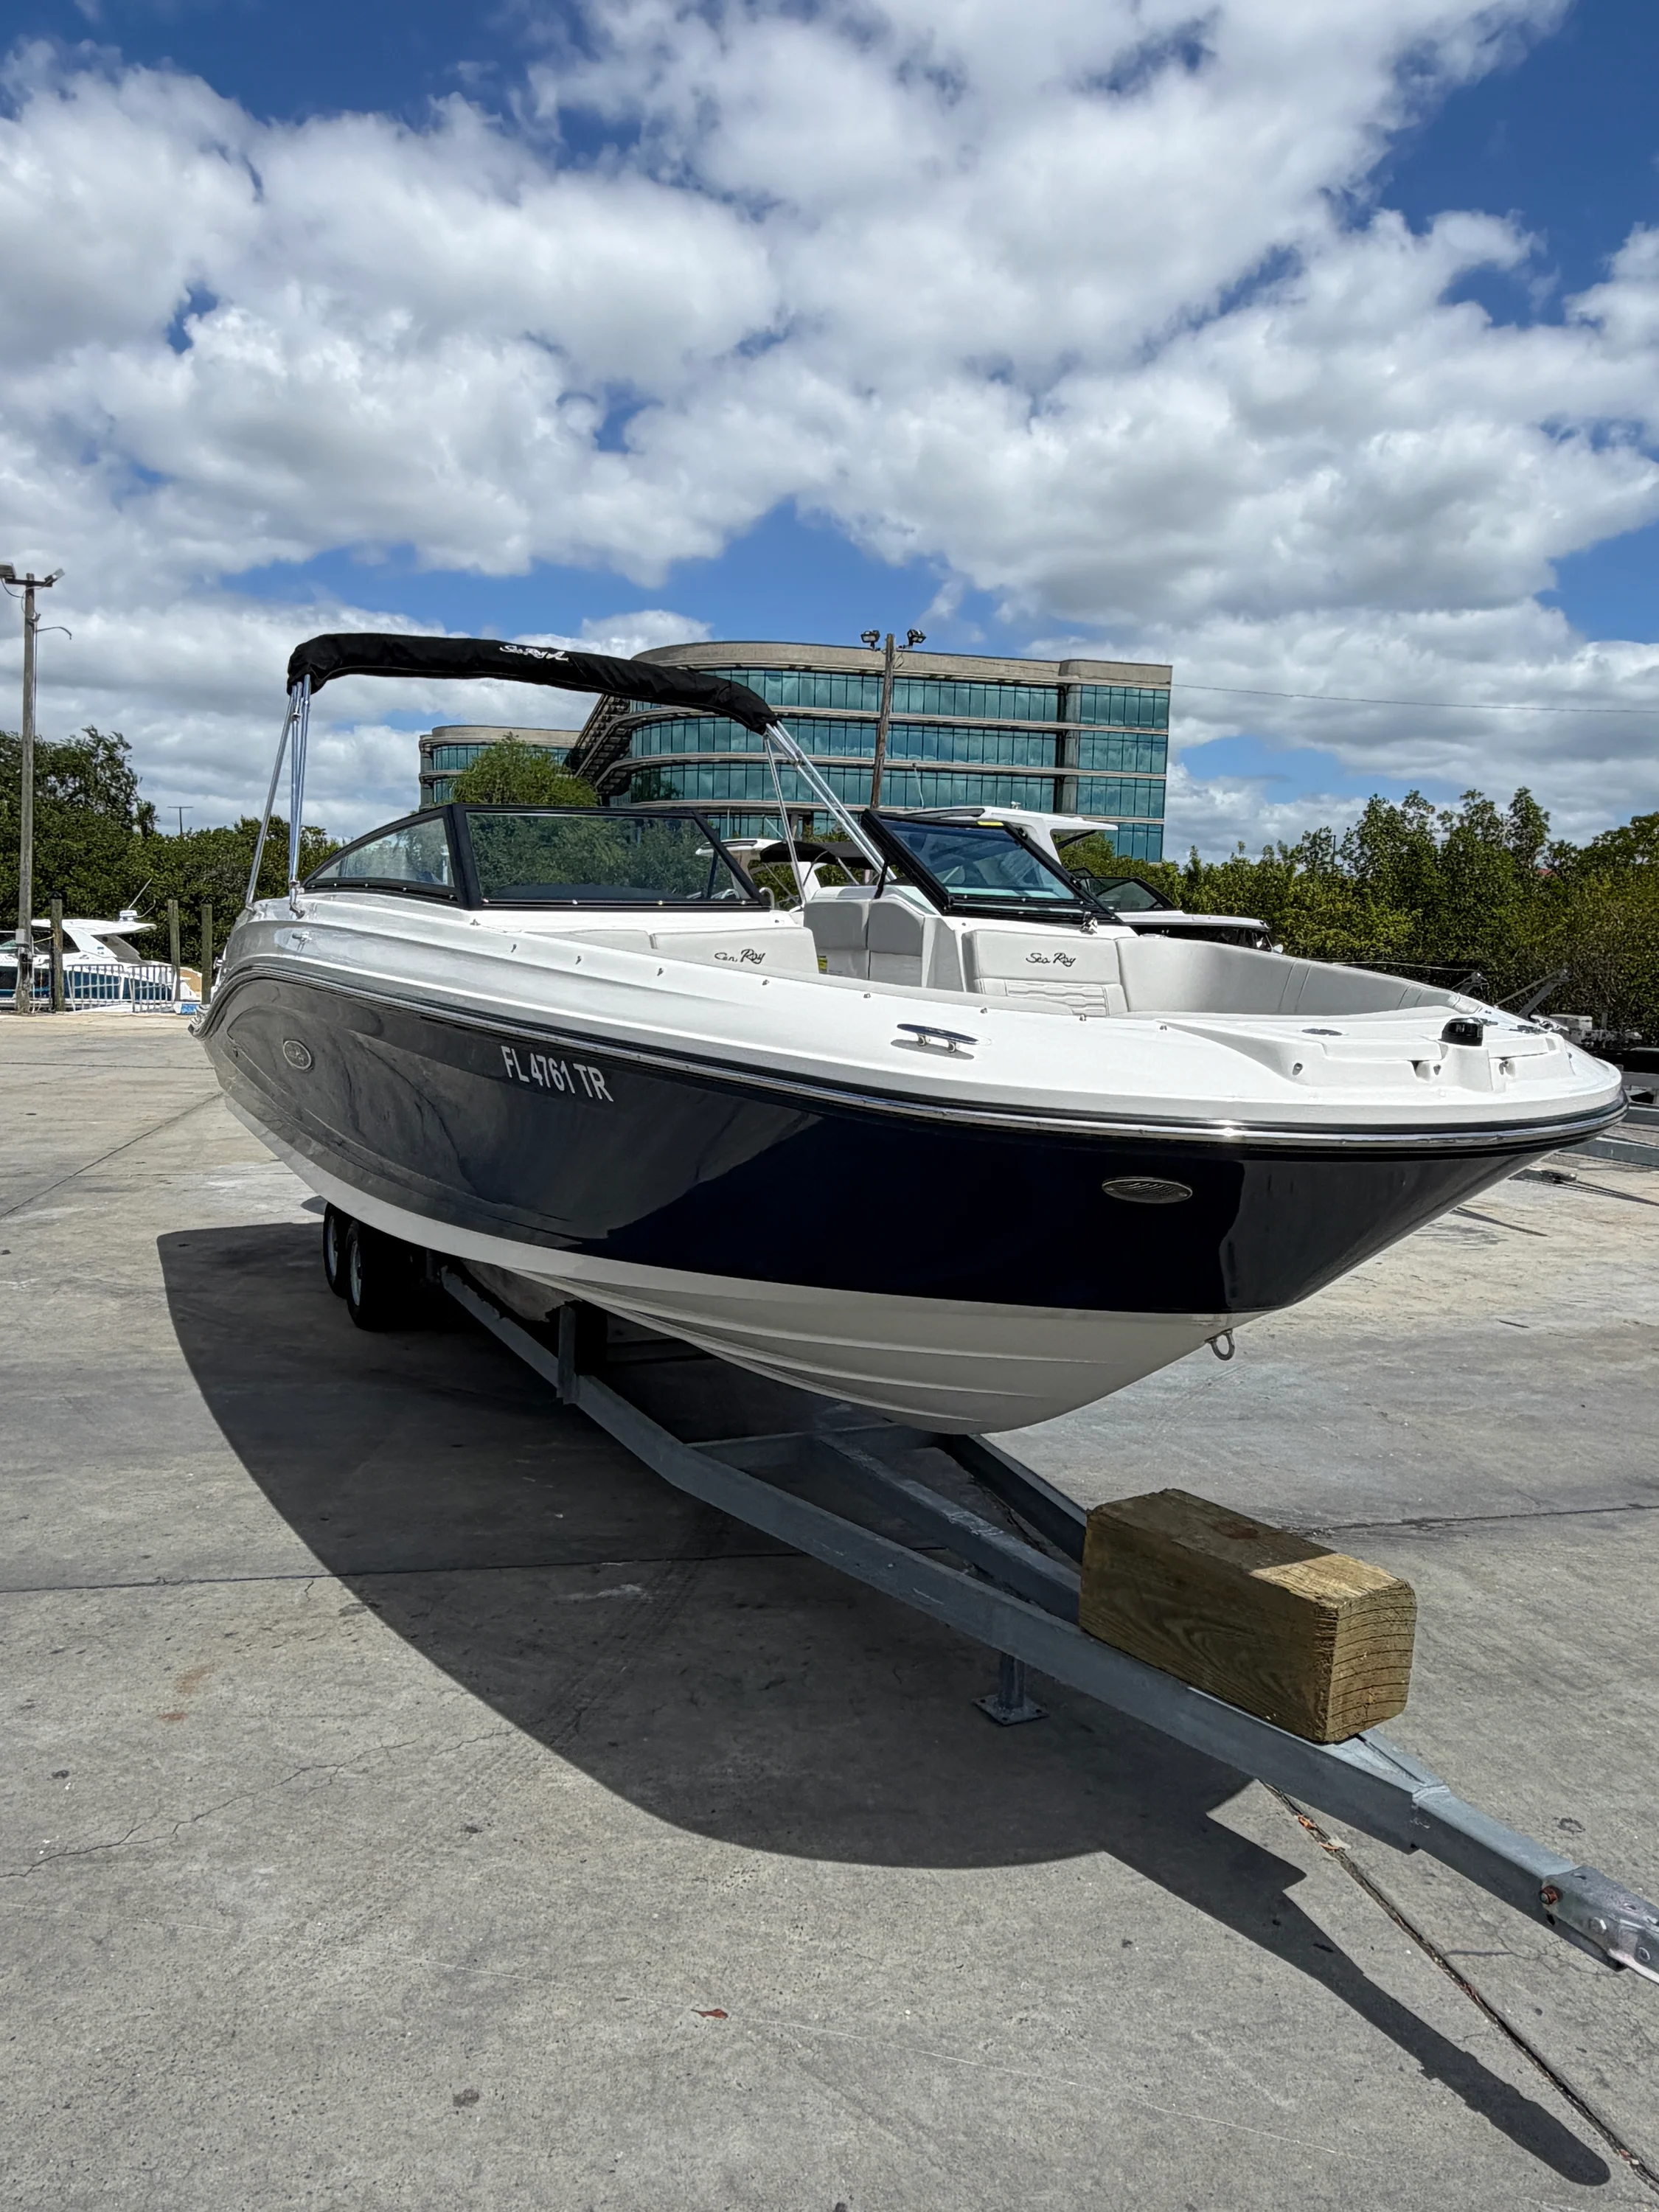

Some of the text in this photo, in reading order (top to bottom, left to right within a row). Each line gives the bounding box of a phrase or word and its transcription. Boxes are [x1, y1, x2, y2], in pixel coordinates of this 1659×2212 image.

[740, 948, 766, 964] Ray
[1026, 953, 1077, 967] Sea Ray
[501, 1046, 614, 1102] FL 4761 TR
